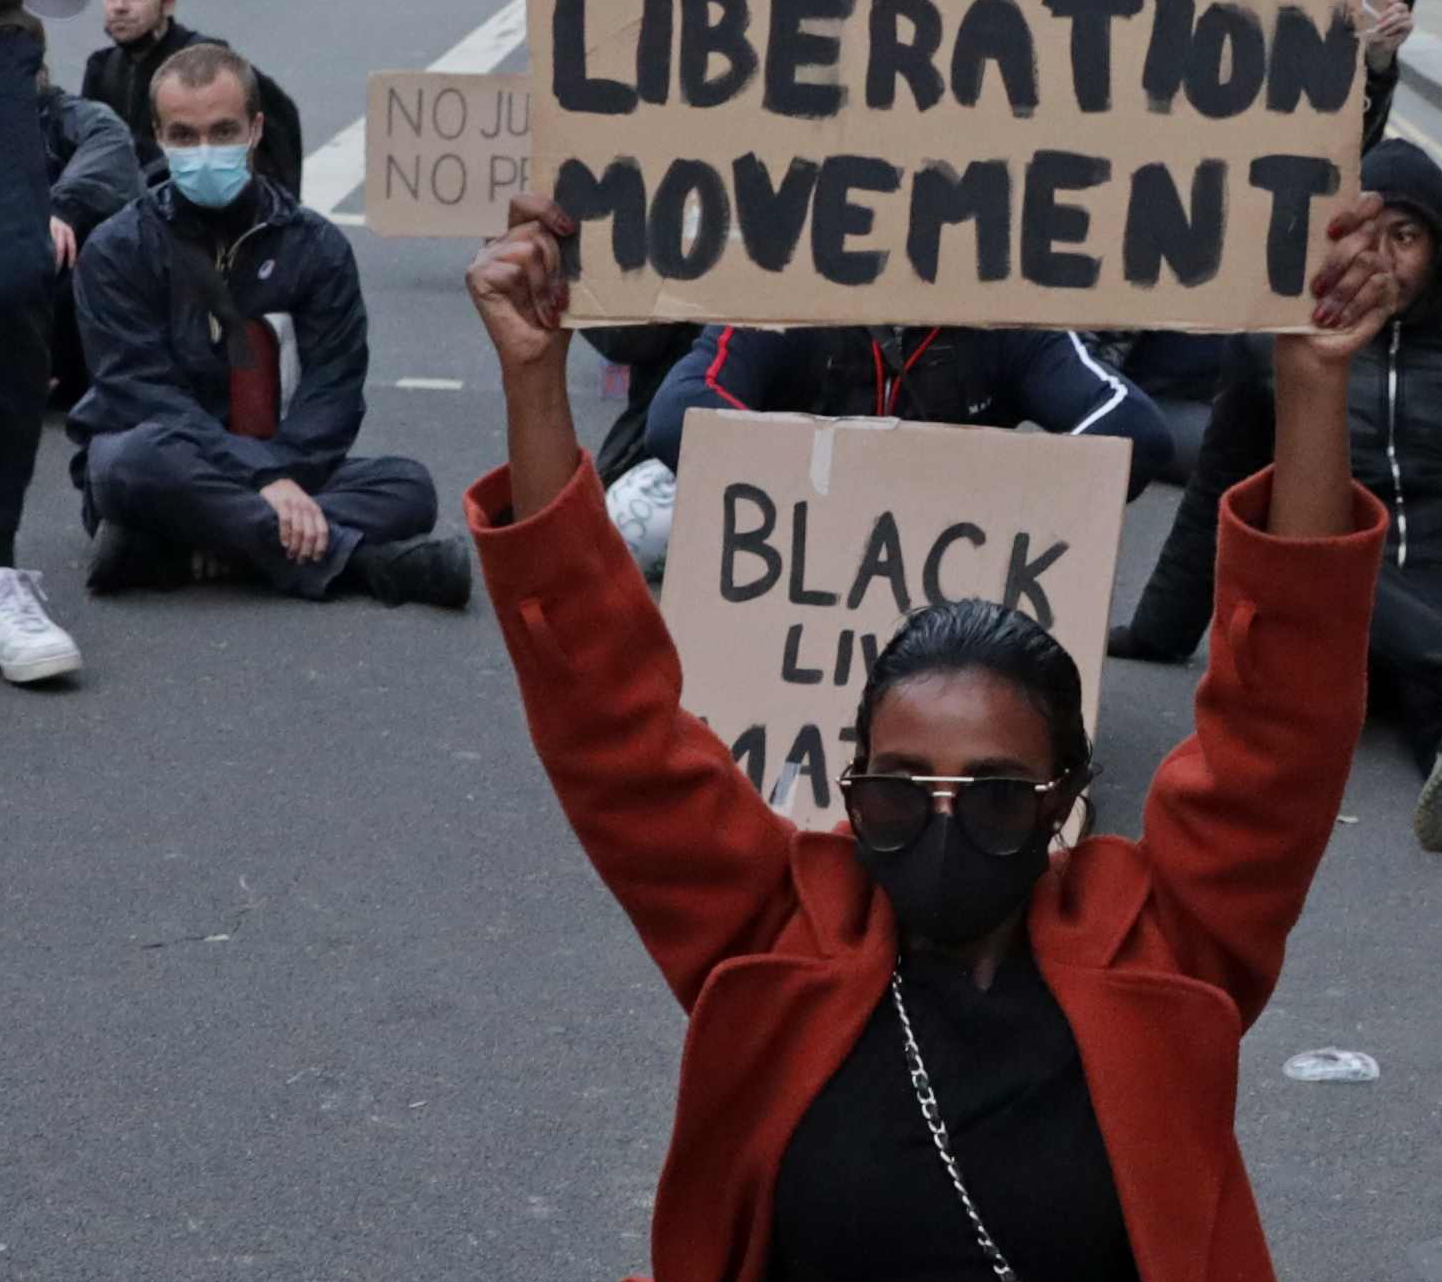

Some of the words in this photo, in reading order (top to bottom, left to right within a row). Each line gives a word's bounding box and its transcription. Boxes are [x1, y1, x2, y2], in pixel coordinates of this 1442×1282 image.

[386, 87, 468, 140] NO
[386, 153, 468, 206] NO
[555, 149, 1340, 297] MOVEMENT
[719, 482, 1070, 630] BLACK
